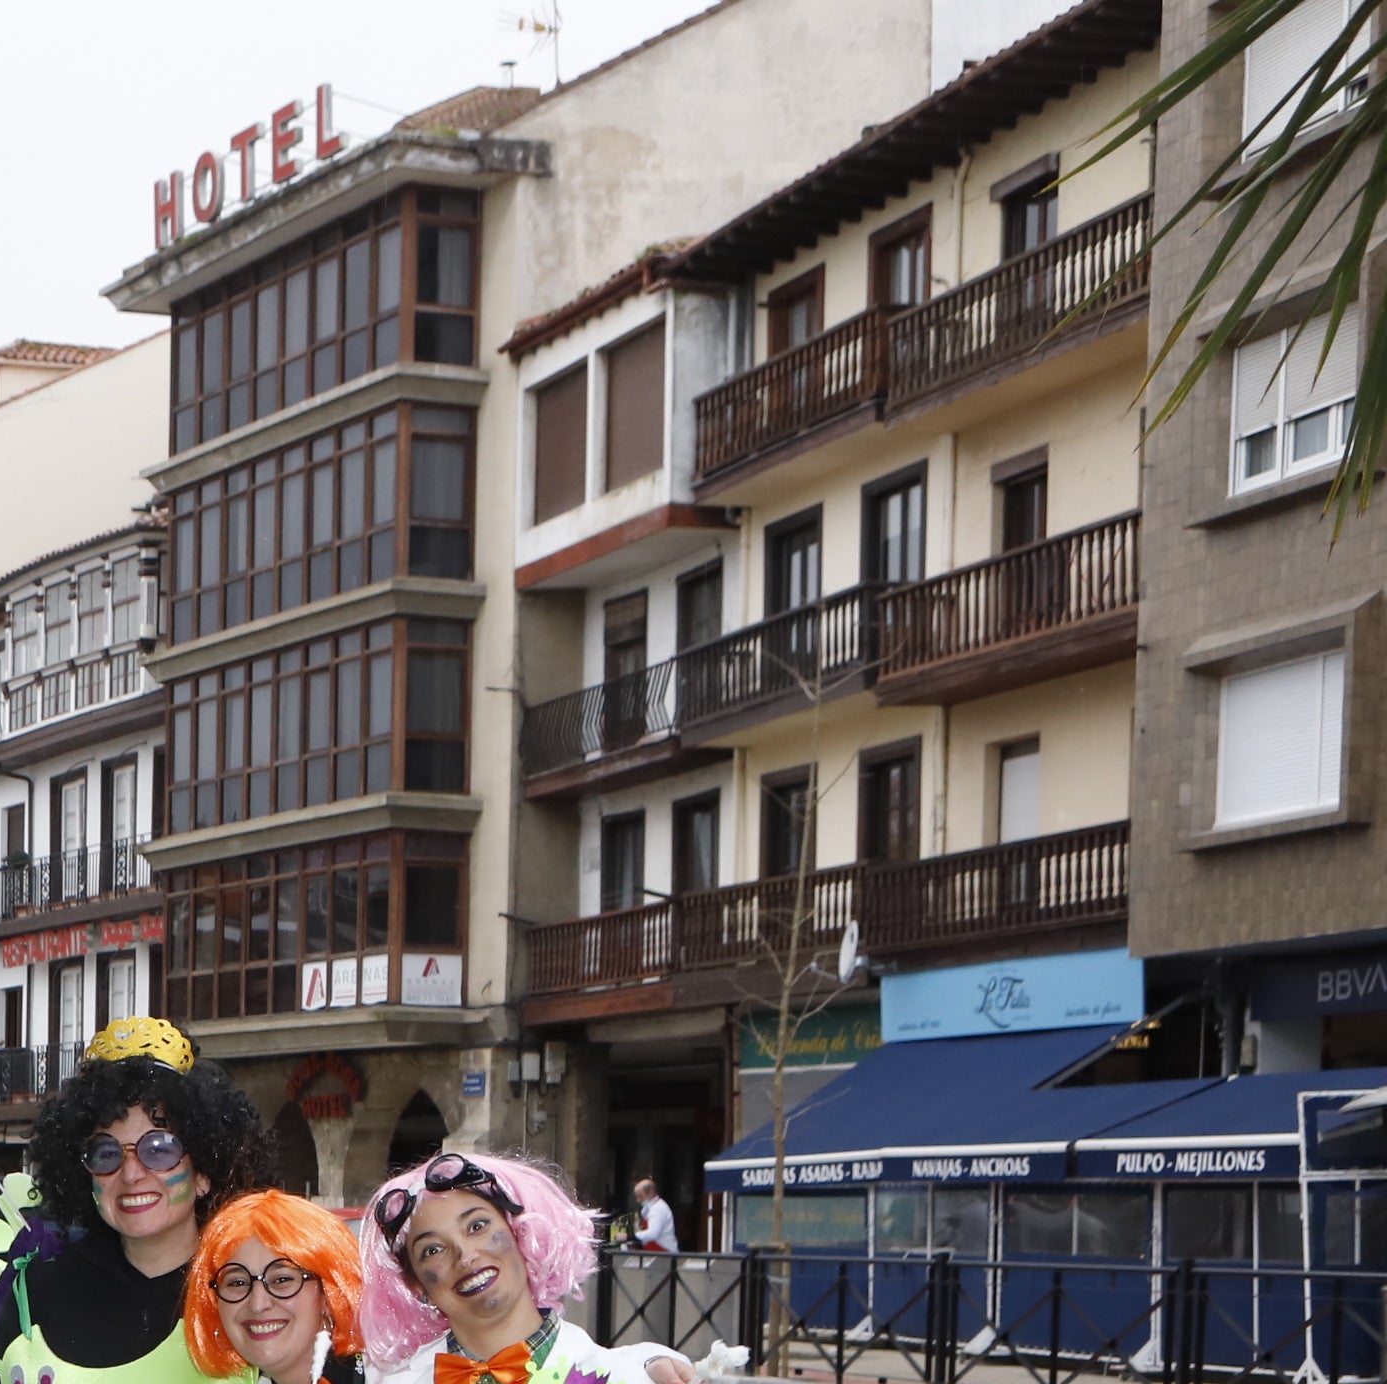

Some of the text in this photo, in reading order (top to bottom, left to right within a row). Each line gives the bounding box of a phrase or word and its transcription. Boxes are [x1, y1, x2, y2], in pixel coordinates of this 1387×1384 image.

[154, 83, 345, 250] HOTEL
[742, 1166, 796, 1187] SARDIAS
[798, 1163, 845, 1184] ASADAS
[911, 1158, 963, 1182] NAVAJAS
[968, 1156, 1031, 1178] ANCHOAS
[1116, 1153, 1166, 1174] PULPO
[1174, 1149, 1266, 1177] MEJILLONES
